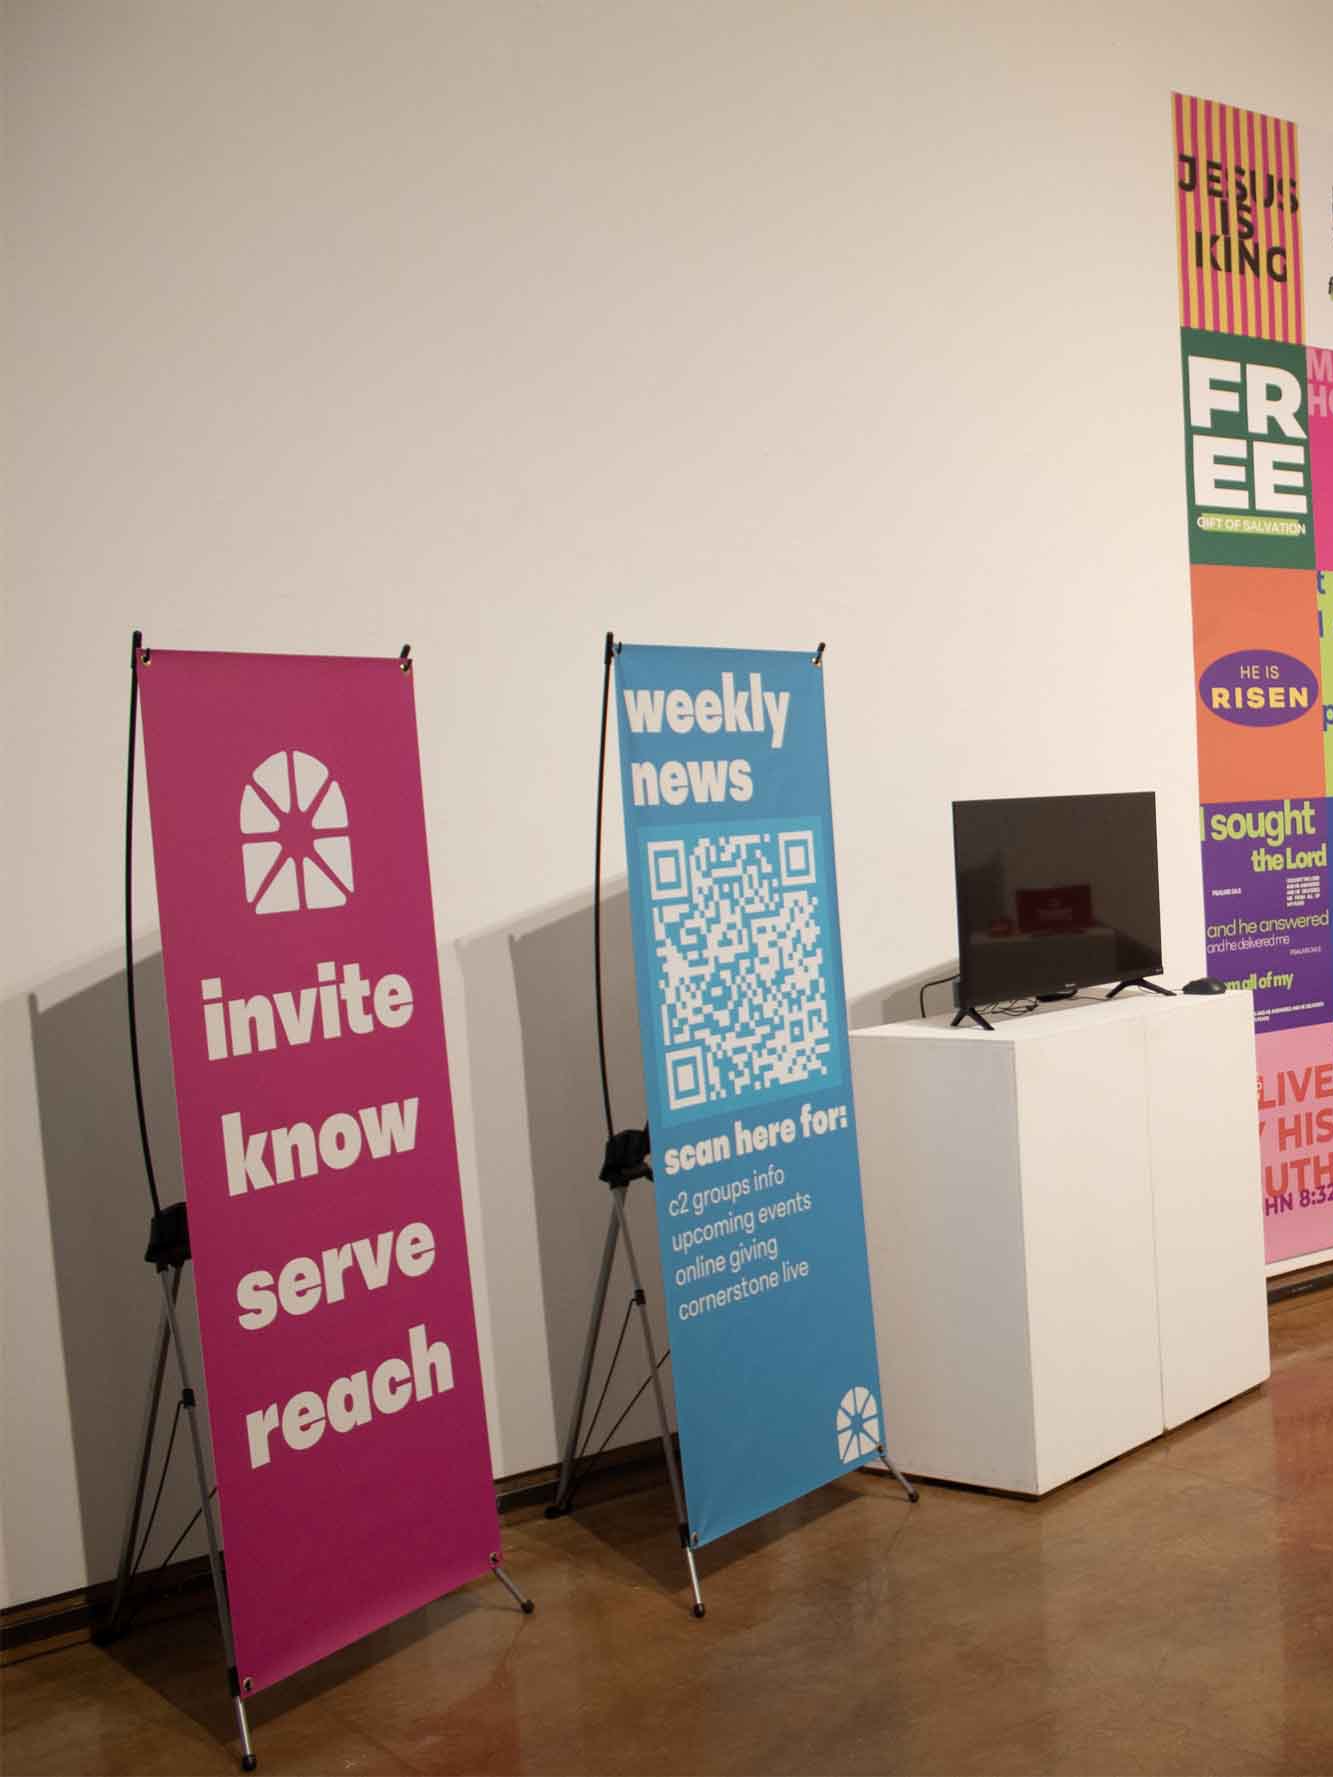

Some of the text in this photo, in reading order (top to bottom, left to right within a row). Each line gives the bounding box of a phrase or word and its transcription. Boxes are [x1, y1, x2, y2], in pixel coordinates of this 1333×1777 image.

[1178, 154, 1299, 214] JESUS
[1196, 231, 1288, 283] KING
[1188, 355, 1308, 439] FR
[1192, 434, 1308, 514] EE
[1241, 518, 1305, 536] SALVATION
[1211, 686, 1309, 709] RISEN
[1240, 665, 1280, 679] HE IS
[624, 672, 790, 748] weekly
[631, 759, 753, 806] news
[1211, 799, 1315, 847] sought
[1251, 843, 1327, 872] the Lord
[1207, 909, 1329, 938] and he answered
[201, 961, 414, 1060] invite
[221, 1097, 419, 1196] know
[665, 1103, 848, 1175] scan here for:
[669, 1164, 784, 1216] c2 groups info
[672, 1192, 812, 1254] upcoming events
[237, 1222, 435, 1330] serve
[675, 1237, 778, 1286] online giving
[679, 1260, 809, 1320] cornerstone live
[246, 1324, 454, 1469] reach
